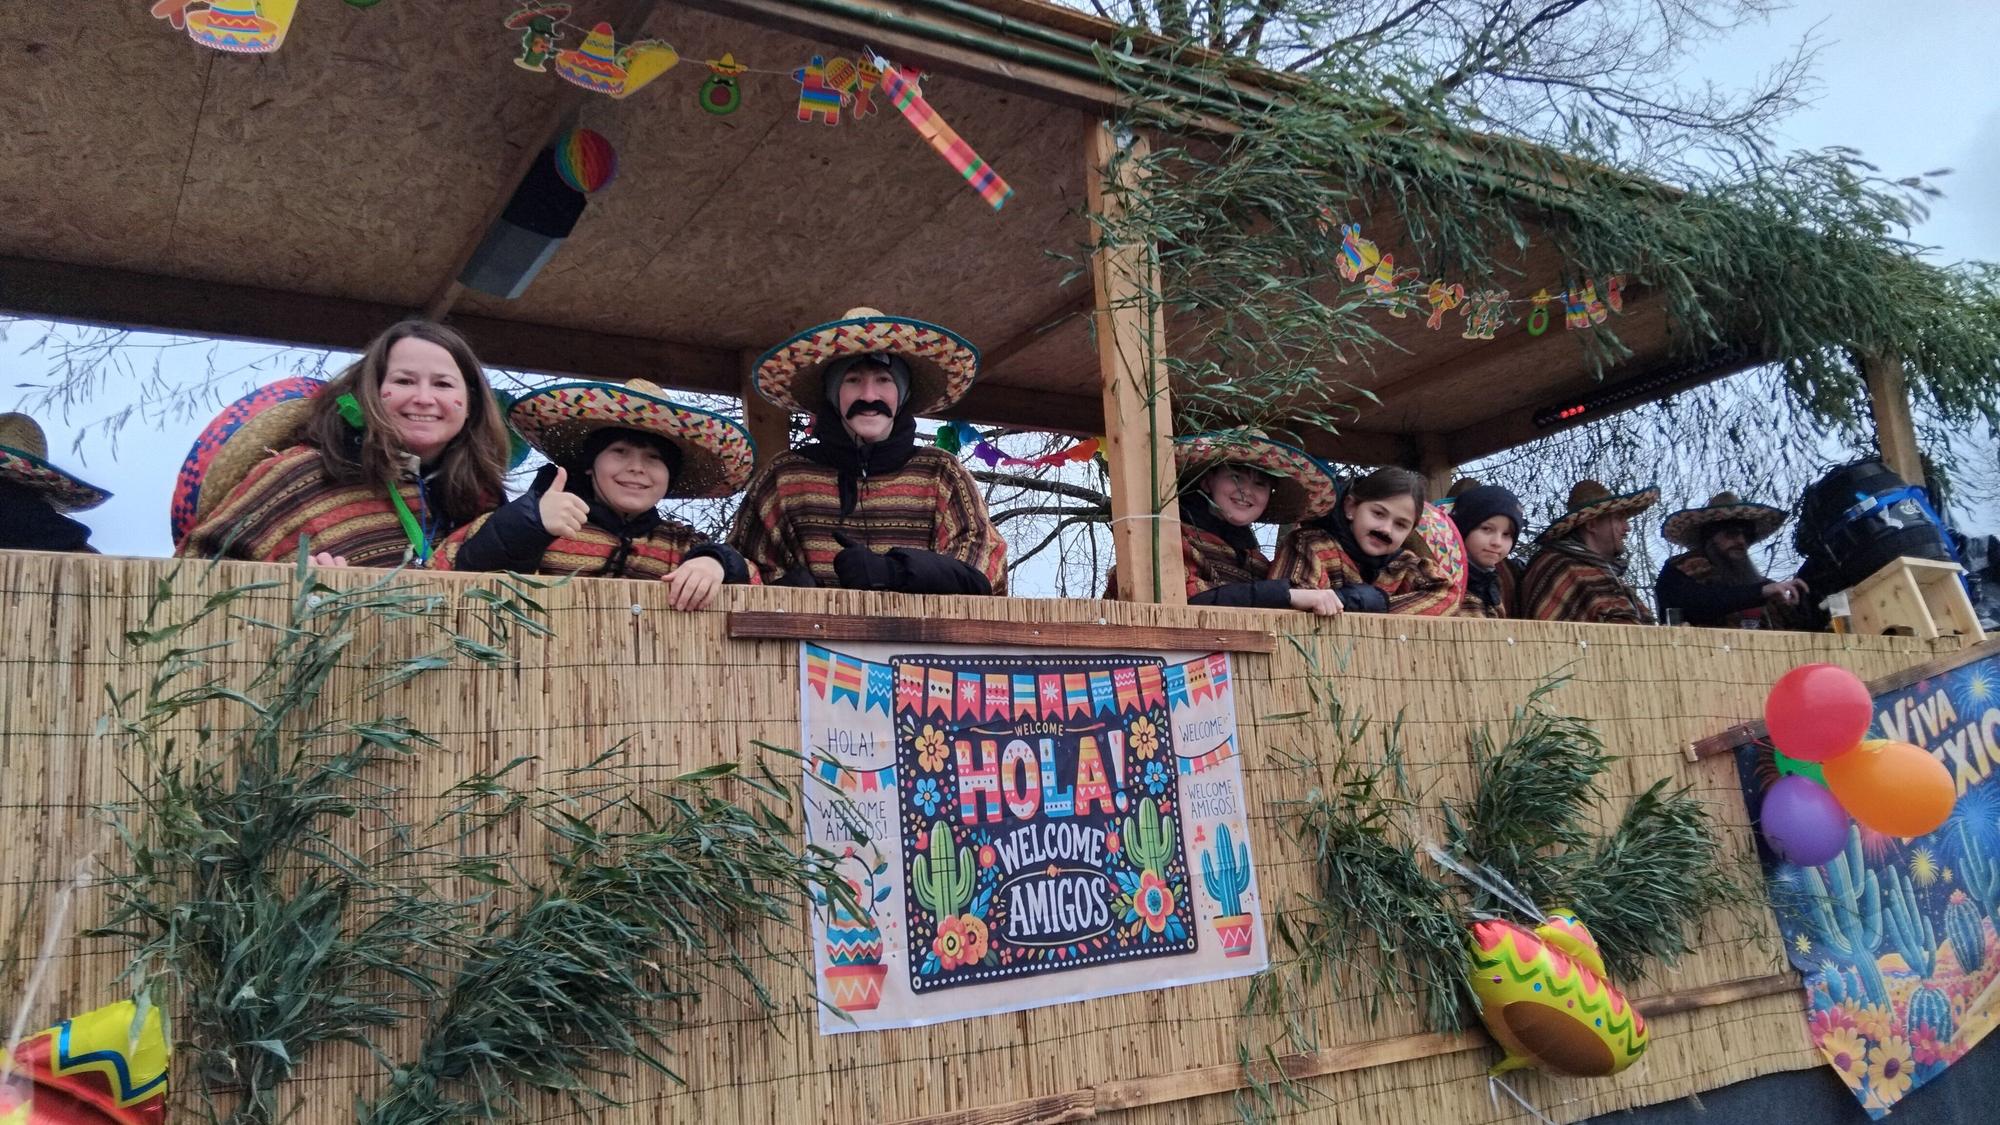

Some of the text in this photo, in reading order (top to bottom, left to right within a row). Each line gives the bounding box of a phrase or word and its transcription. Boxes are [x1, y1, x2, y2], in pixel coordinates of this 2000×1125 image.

[827, 727, 875, 757] HOLA!
[1014, 722, 1064, 737] WELCOME
[1178, 716, 1224, 742] WELCOME
[954, 729, 1129, 825] HOLA!
[1187, 780, 1233, 799] WELCOME
[1191, 795, 1237, 819] AMIGOS!
[994, 822, 1106, 875] WELCOME
[1008, 876, 1109, 937] AMIGOS
